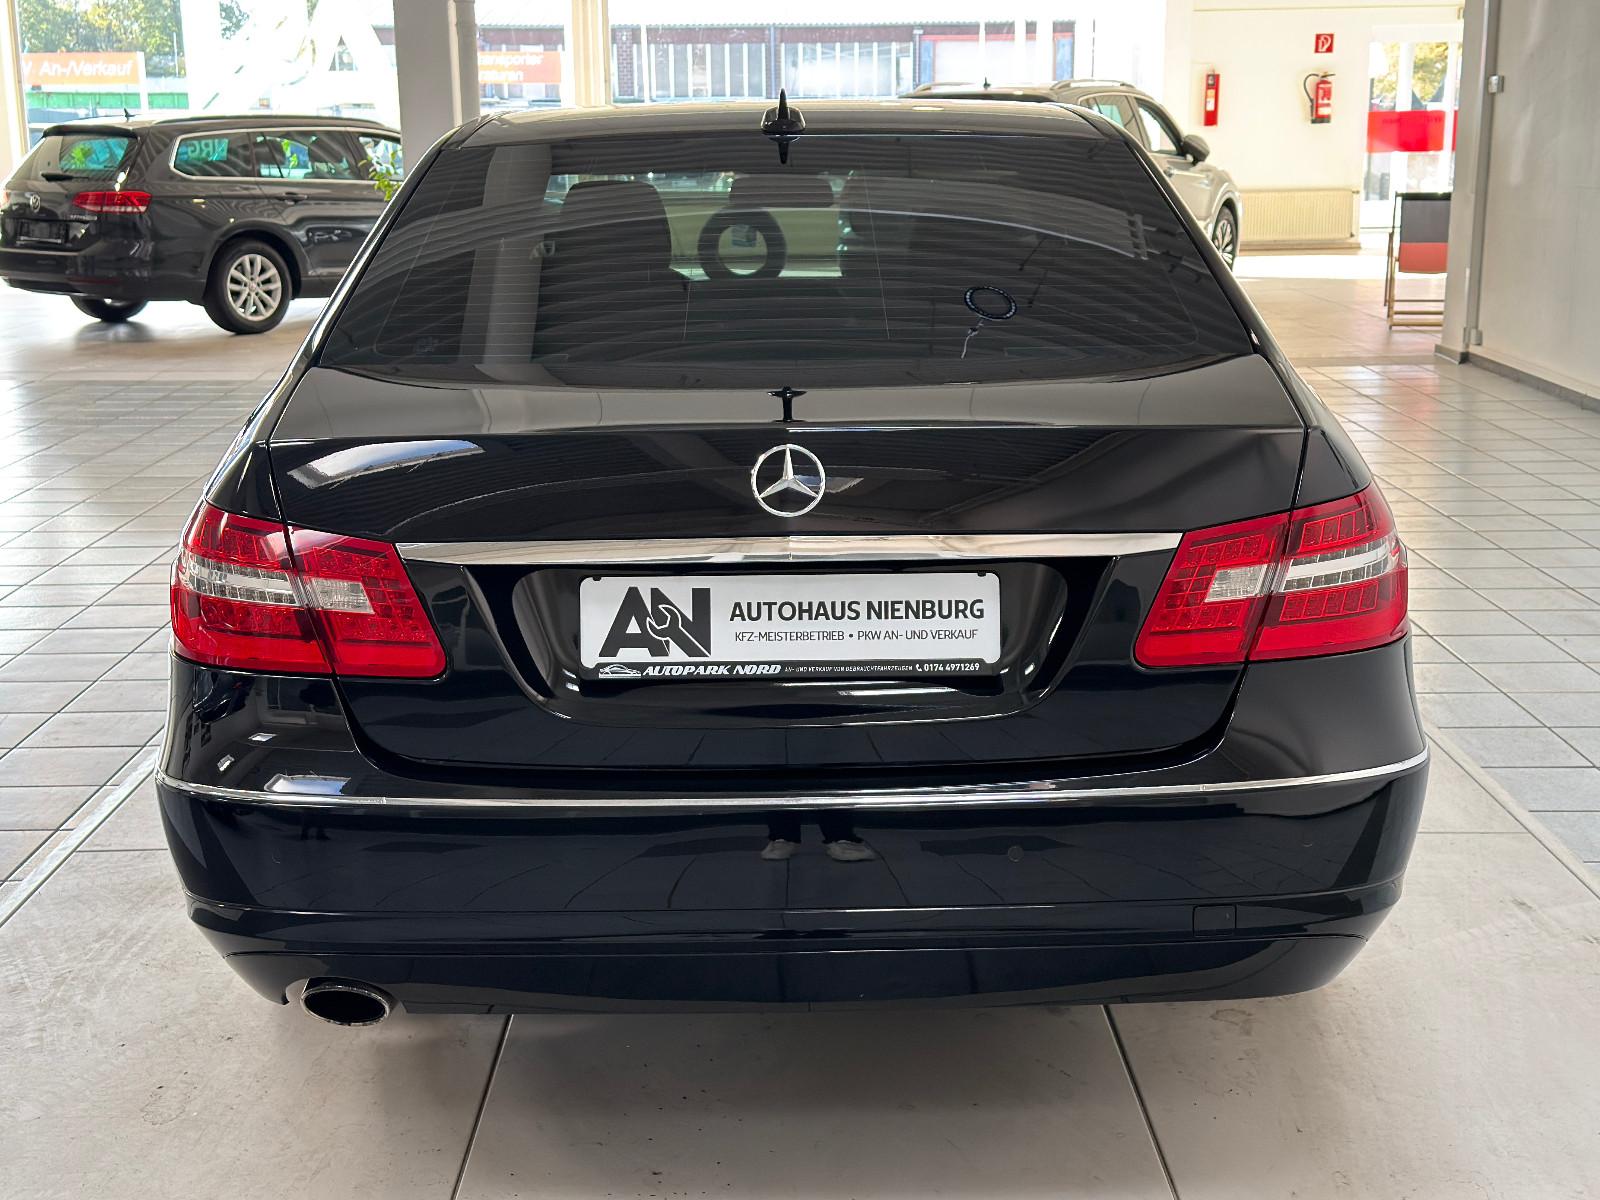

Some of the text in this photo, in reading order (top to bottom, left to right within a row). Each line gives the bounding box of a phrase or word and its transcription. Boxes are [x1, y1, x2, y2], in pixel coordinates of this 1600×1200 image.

[729, 599, 985, 621] AUTOHAUS NIENBURG
[598, 586, 711, 658] AN
[735, 629, 979, 642] KFZ-MEISTERBETRIEB PKW AN- UND VERKAUF
[643, 664, 781, 676] AUTOPARK NORD
[923, 662, 980, 672] 0174 4971269
